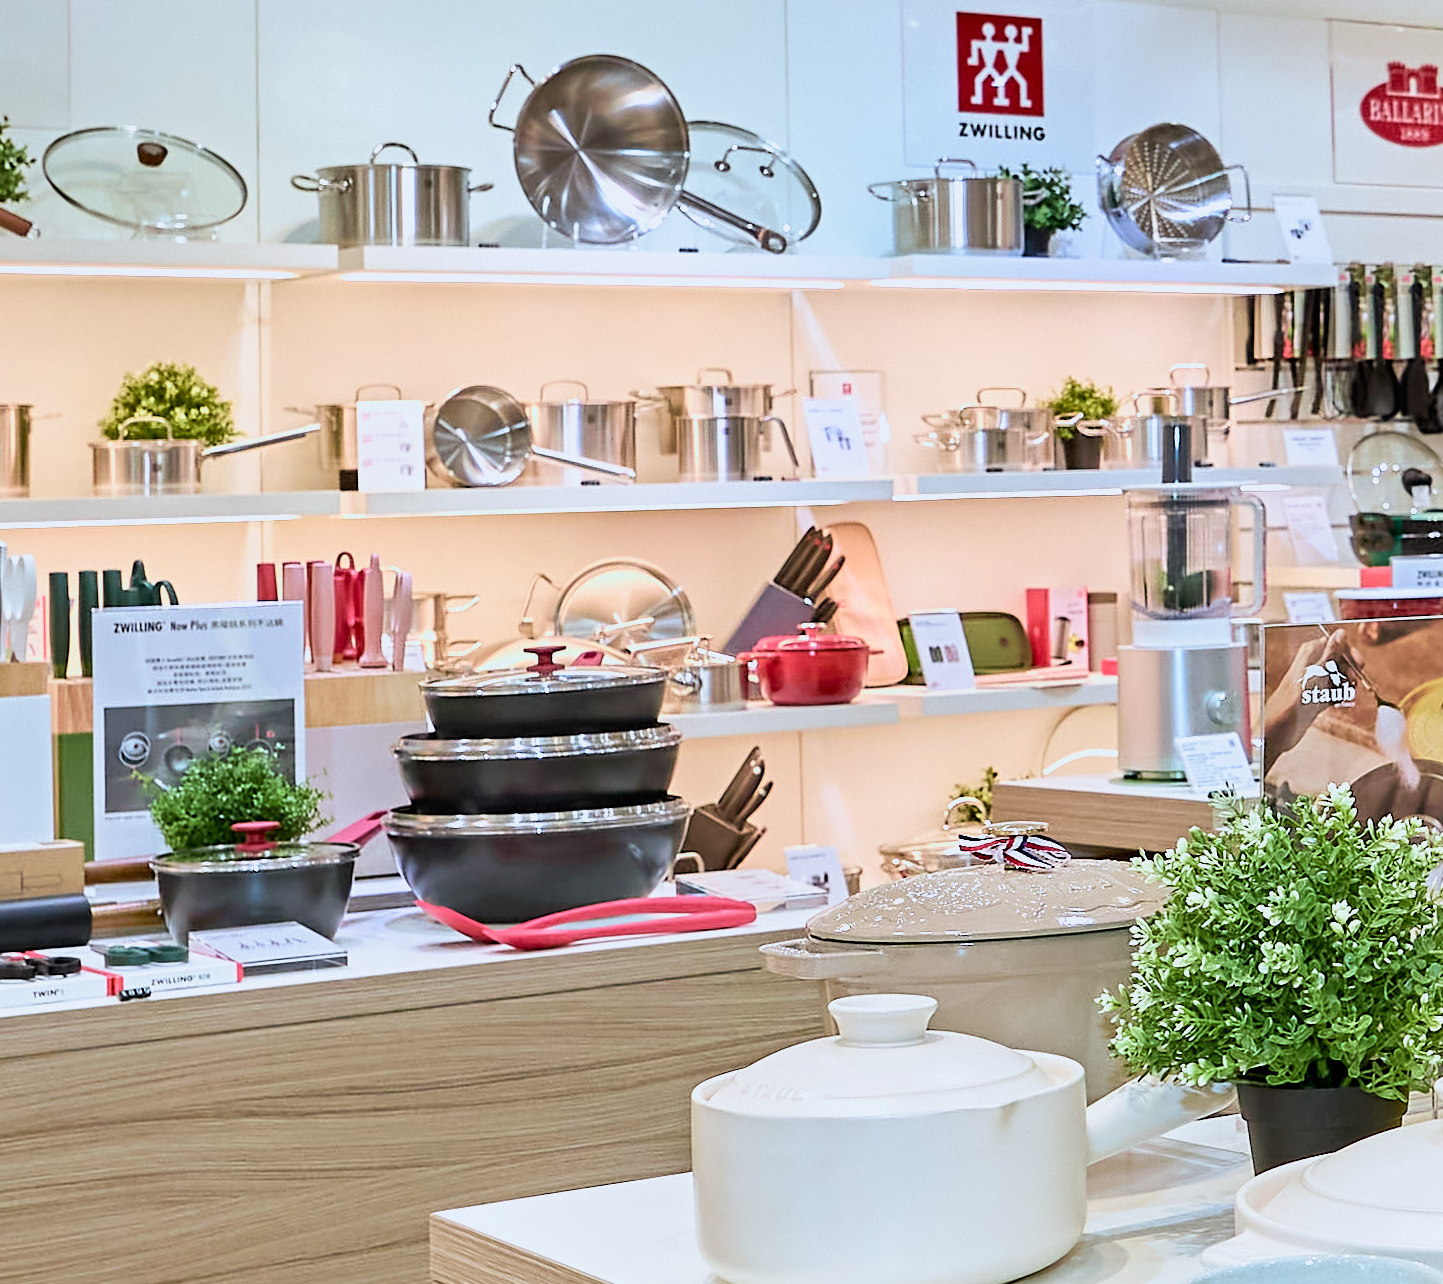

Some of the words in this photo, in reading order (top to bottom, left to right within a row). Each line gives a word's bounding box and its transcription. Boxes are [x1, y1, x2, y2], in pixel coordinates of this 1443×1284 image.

[959, 122, 1046, 142] ZWILLING
[114, 621, 163, 634] ZWILLING
[1302, 683, 1355, 705] staub
[151, 975, 195, 986] ZWILLING
[33, 989, 57, 999] TWIN
